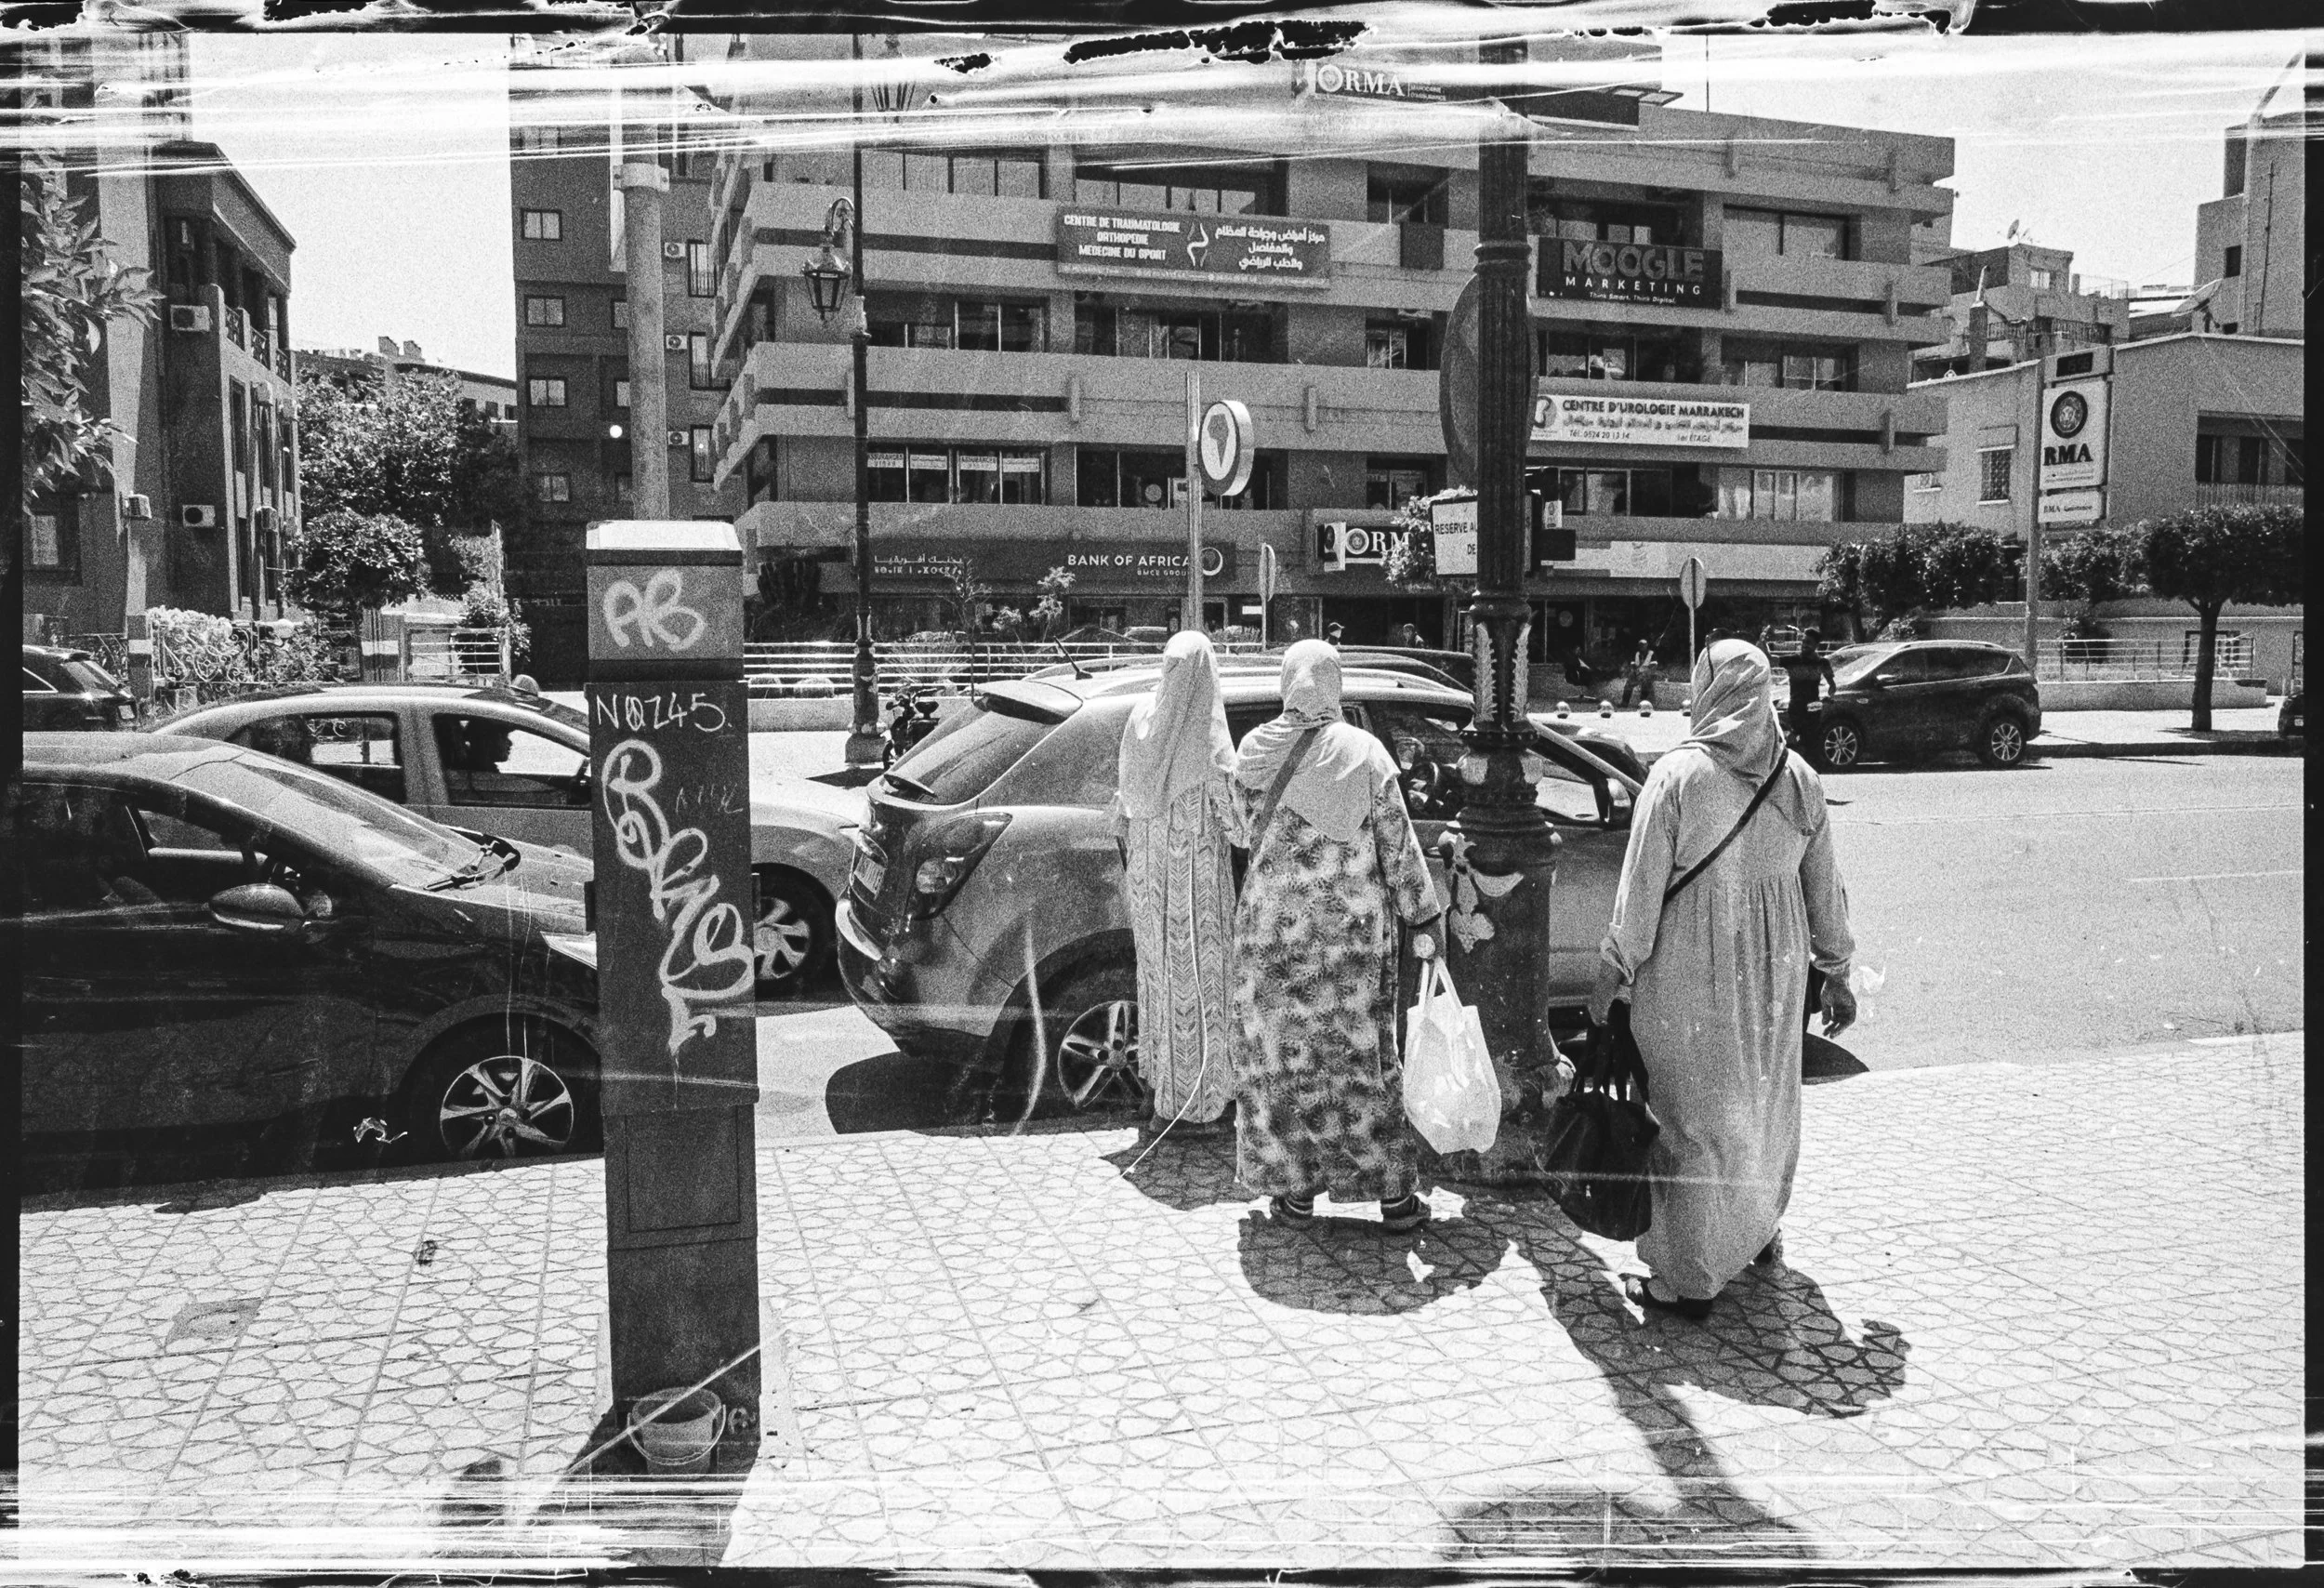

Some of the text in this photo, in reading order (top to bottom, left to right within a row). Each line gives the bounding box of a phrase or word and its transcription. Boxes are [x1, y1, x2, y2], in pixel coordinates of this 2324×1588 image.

[1063, 214, 1181, 233] CENTRE DE TRAUMATOLOGIE
[1123, 246, 1136, 258] DU
[1138, 248, 1167, 261] SPORT
[1563, 240, 1705, 283] MOOGLE
[1565, 276, 1701, 296] MARKETING
[1563, 399, 1745, 418] CENTRE D'UROLOGIE MARRAKECH
[2042, 443, 2093, 466] RMA
[1434, 522, 1468, 536] RESERVE
[1067, 554, 1190, 567] BANK OF AFRICA
[1137, 568, 1160, 576] BMCE
